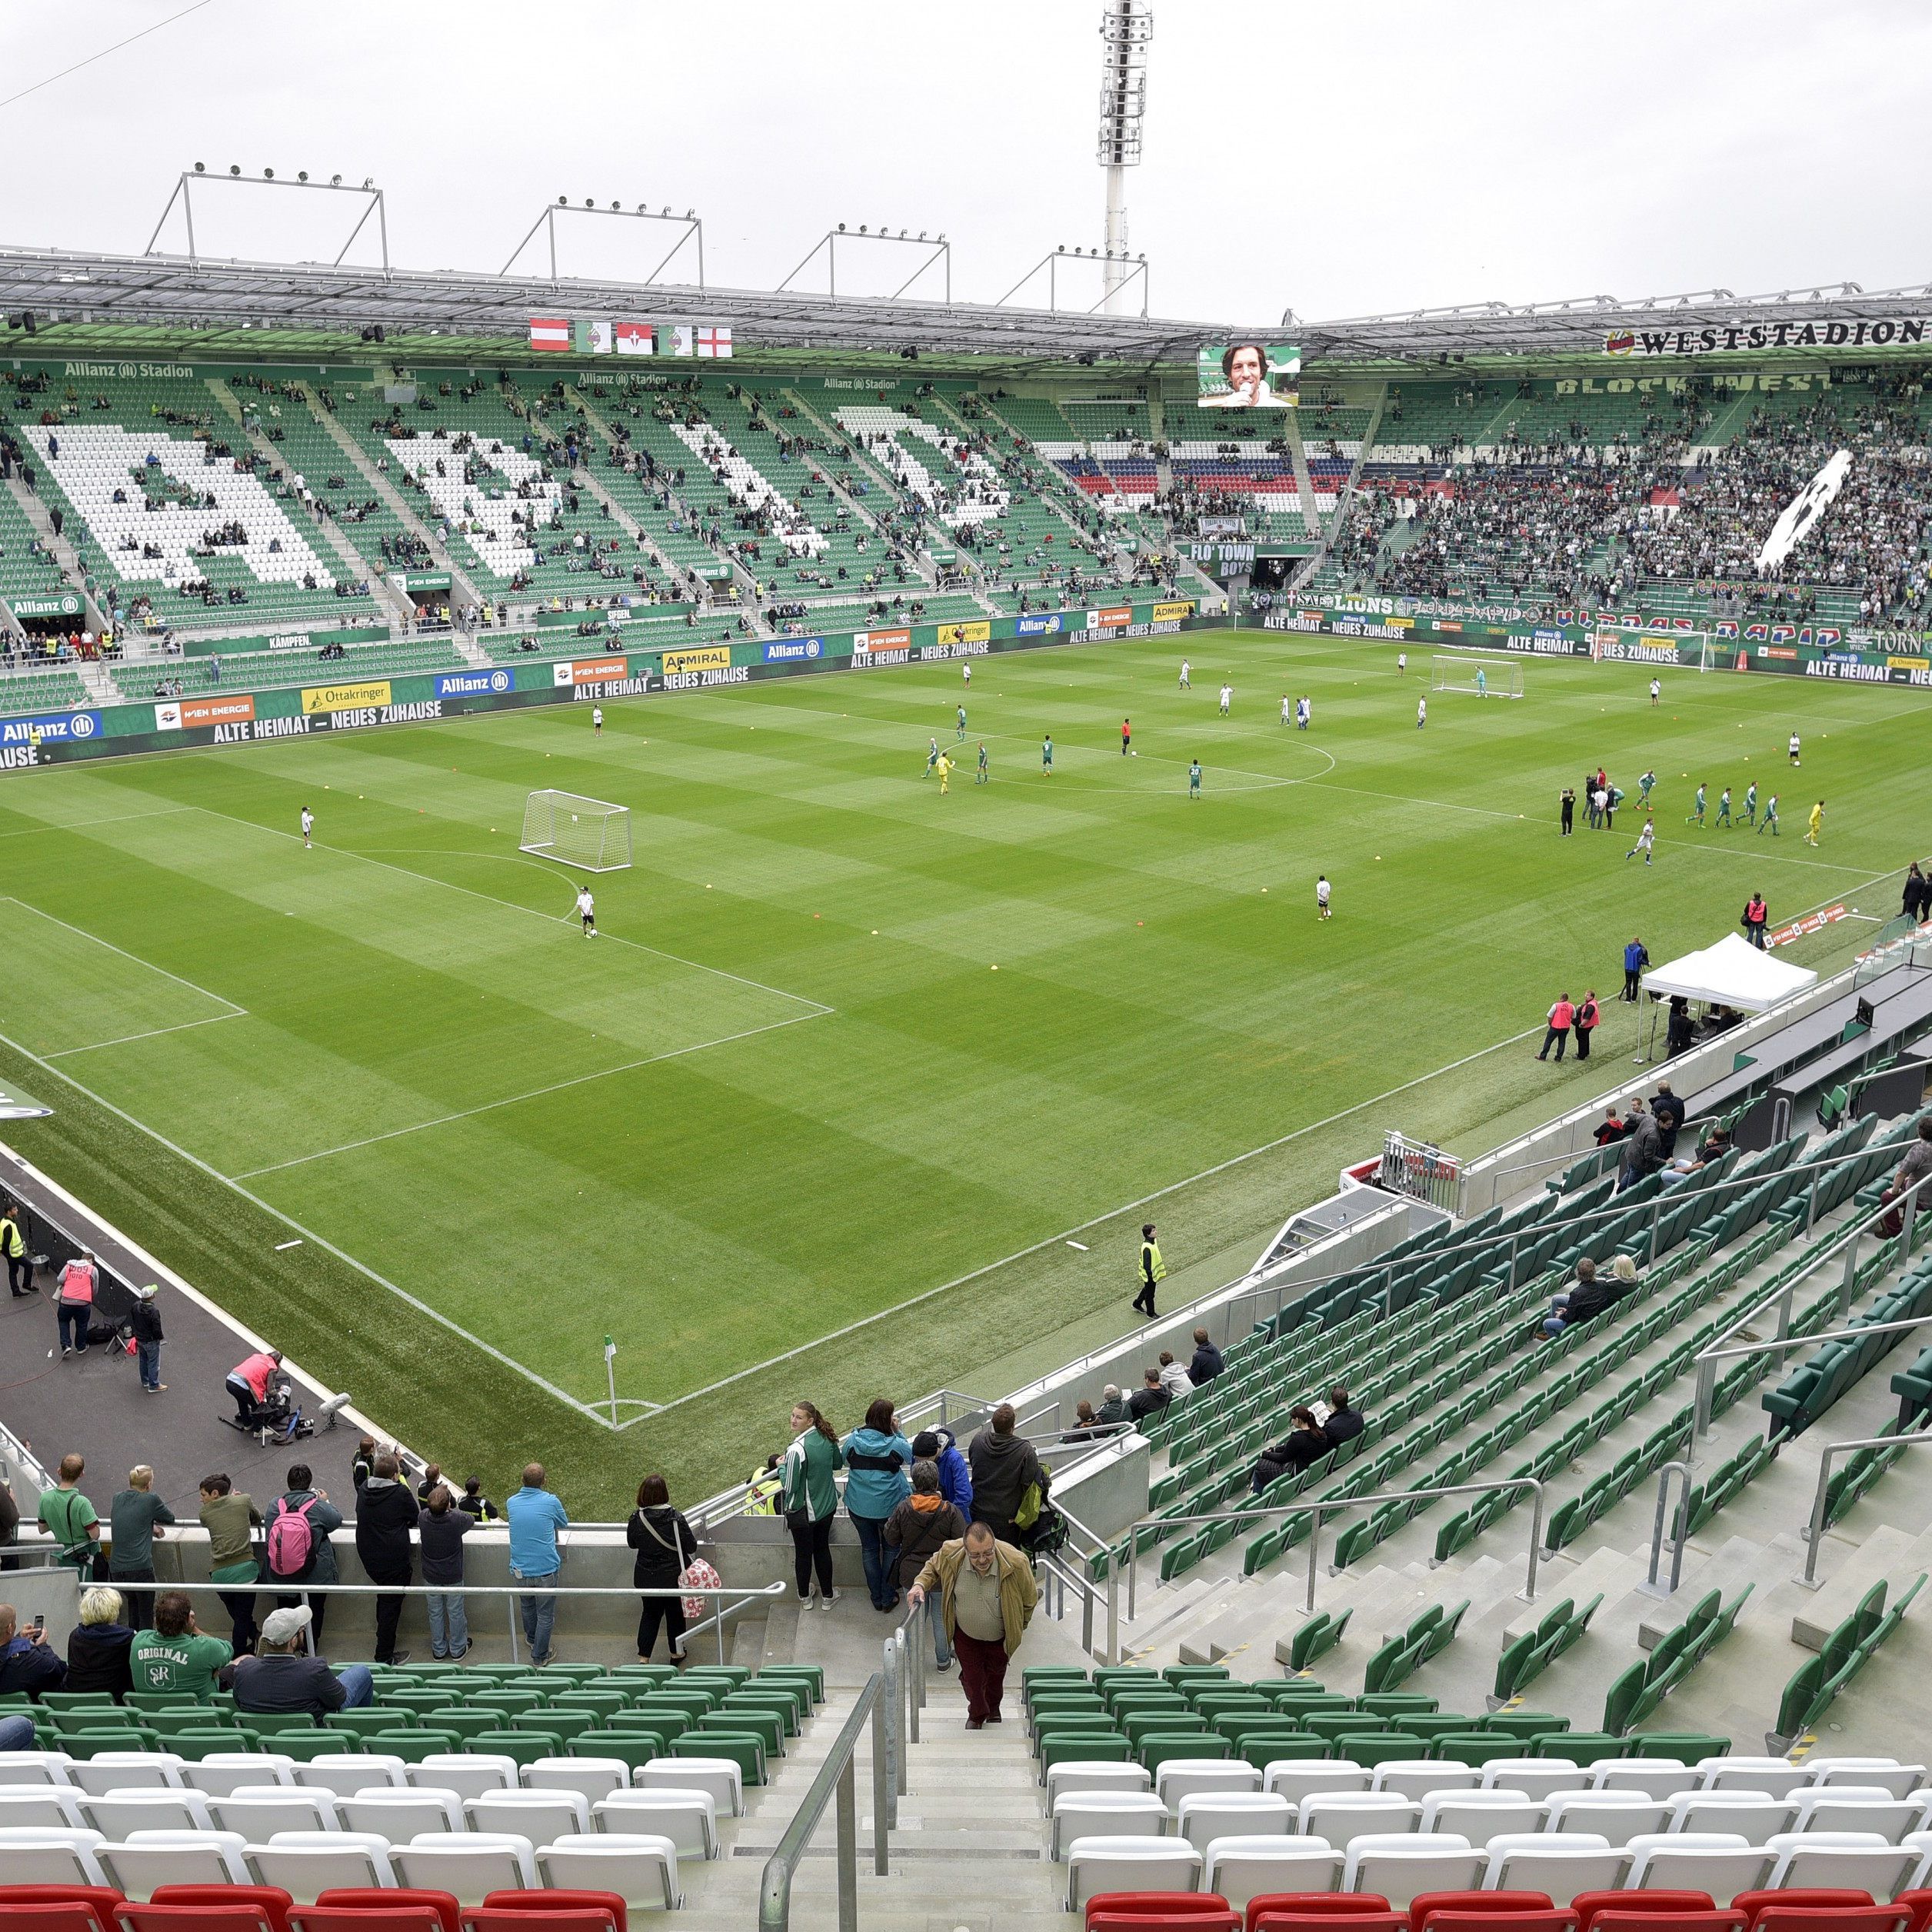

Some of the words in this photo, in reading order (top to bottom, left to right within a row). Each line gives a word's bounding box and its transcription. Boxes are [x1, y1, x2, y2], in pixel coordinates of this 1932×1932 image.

[1641, 319, 1926, 355] WESTSTADION
[65, 362, 115, 376] Allianz
[140, 364, 193, 377] Stadion
[579, 372, 614, 385] Allianz
[630, 372, 667, 385] Stadion
[824, 378, 852, 388] Allianz
[865, 378, 895, 389] Stadion
[1556, 377, 1687, 394] BLOCK
[1713, 373, 1833, 391] WEST
[1217, 545, 1255, 561] TOWN
[1221, 561, 1254, 577] BOYS
[425, 577, 450, 585] ENERGIE
[14, 601, 59, 614] Allianz
[1155, 605, 1188, 617] ADMIRA
[1334, 595, 1393, 614] LIONS
[608, 609, 631, 620] SIEGEN.
[951, 625, 987, 636] Okringer
[1020, 618, 1047, 631] Allian
[1069, 630, 1087, 644] ALTE
[1089, 627, 1117, 641] HEIMAT
[1126, 624, 1148, 637] NEUES
[1150, 620, 1181, 634] ZUHAUSE
[1264, 616, 1284, 630] ALTE
[1287, 618, 1321, 632] HEIMAT
[1332, 621, 1361, 636] NEUES
[1363, 624, 1405, 639] ZUHAUSE
[1556, 609, 1694, 631] ULTRAS
[1715, 621, 1841, 647] RAPID
[269, 635, 311, 649] KÄMPFEN.
[885, 635, 908, 644] ENERGIE
[1874, 629, 1922, 654] TORN
[768, 645, 804, 659] Allianz
[851, 652, 873, 668] ALTE
[874, 648, 909, 666] HEIMAT
[921, 645, 949, 661] NEUES
[951, 640, 989, 656] ZUHAUSE
[1507, 635, 1531, 650] ALTE
[1534, 638, 1575, 654] HEIMAT
[1589, 641, 1624, 658] NEUES
[1627, 645, 1679, 663] ZUHAUSE
[665, 651, 728, 669] ADMIRAL
[575, 668, 594, 676] WIEN
[595, 665, 624, 675] ENERGIE
[1806, 660, 1837, 678] ALTE
[1840, 662, 1892, 681] HEIMAT
[441, 678, 489, 693] Allianz
[574, 684, 601, 701] ALTE
[605, 678, 648, 698] HEIMAT
[664, 672, 698, 690] NEUES
[701, 665, 749, 685] ZUHAUSE
[325, 688, 385, 703] Ottakringer
[185, 708, 209, 718] WIEN
[212, 704, 249, 716] ENERGIE
[214, 721, 249, 744] ALTE
[254, 715, 311, 738] HEIMAT
[331, 707, 377, 729] NEUES
[381, 701, 442, 724] ZUHAUSE
[4, 721, 68, 741] Allianz
[138, 1647, 188, 1665] ORIGINAL
